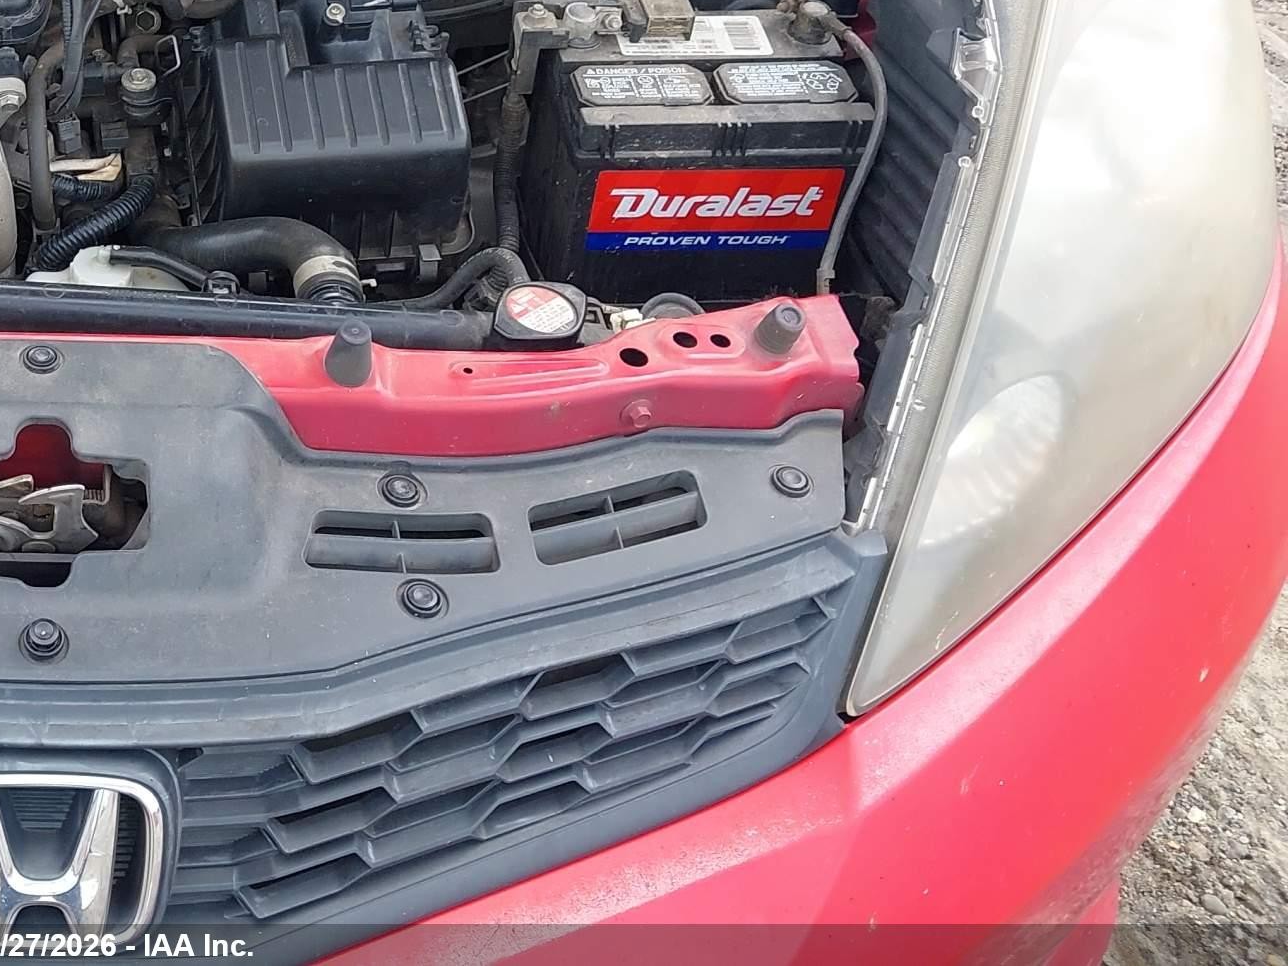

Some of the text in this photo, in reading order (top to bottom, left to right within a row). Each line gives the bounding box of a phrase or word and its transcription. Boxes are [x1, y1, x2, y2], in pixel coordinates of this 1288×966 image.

[610, 186, 823, 219] Duralast
[623, 235, 788, 246] PROVEN TOUGH
